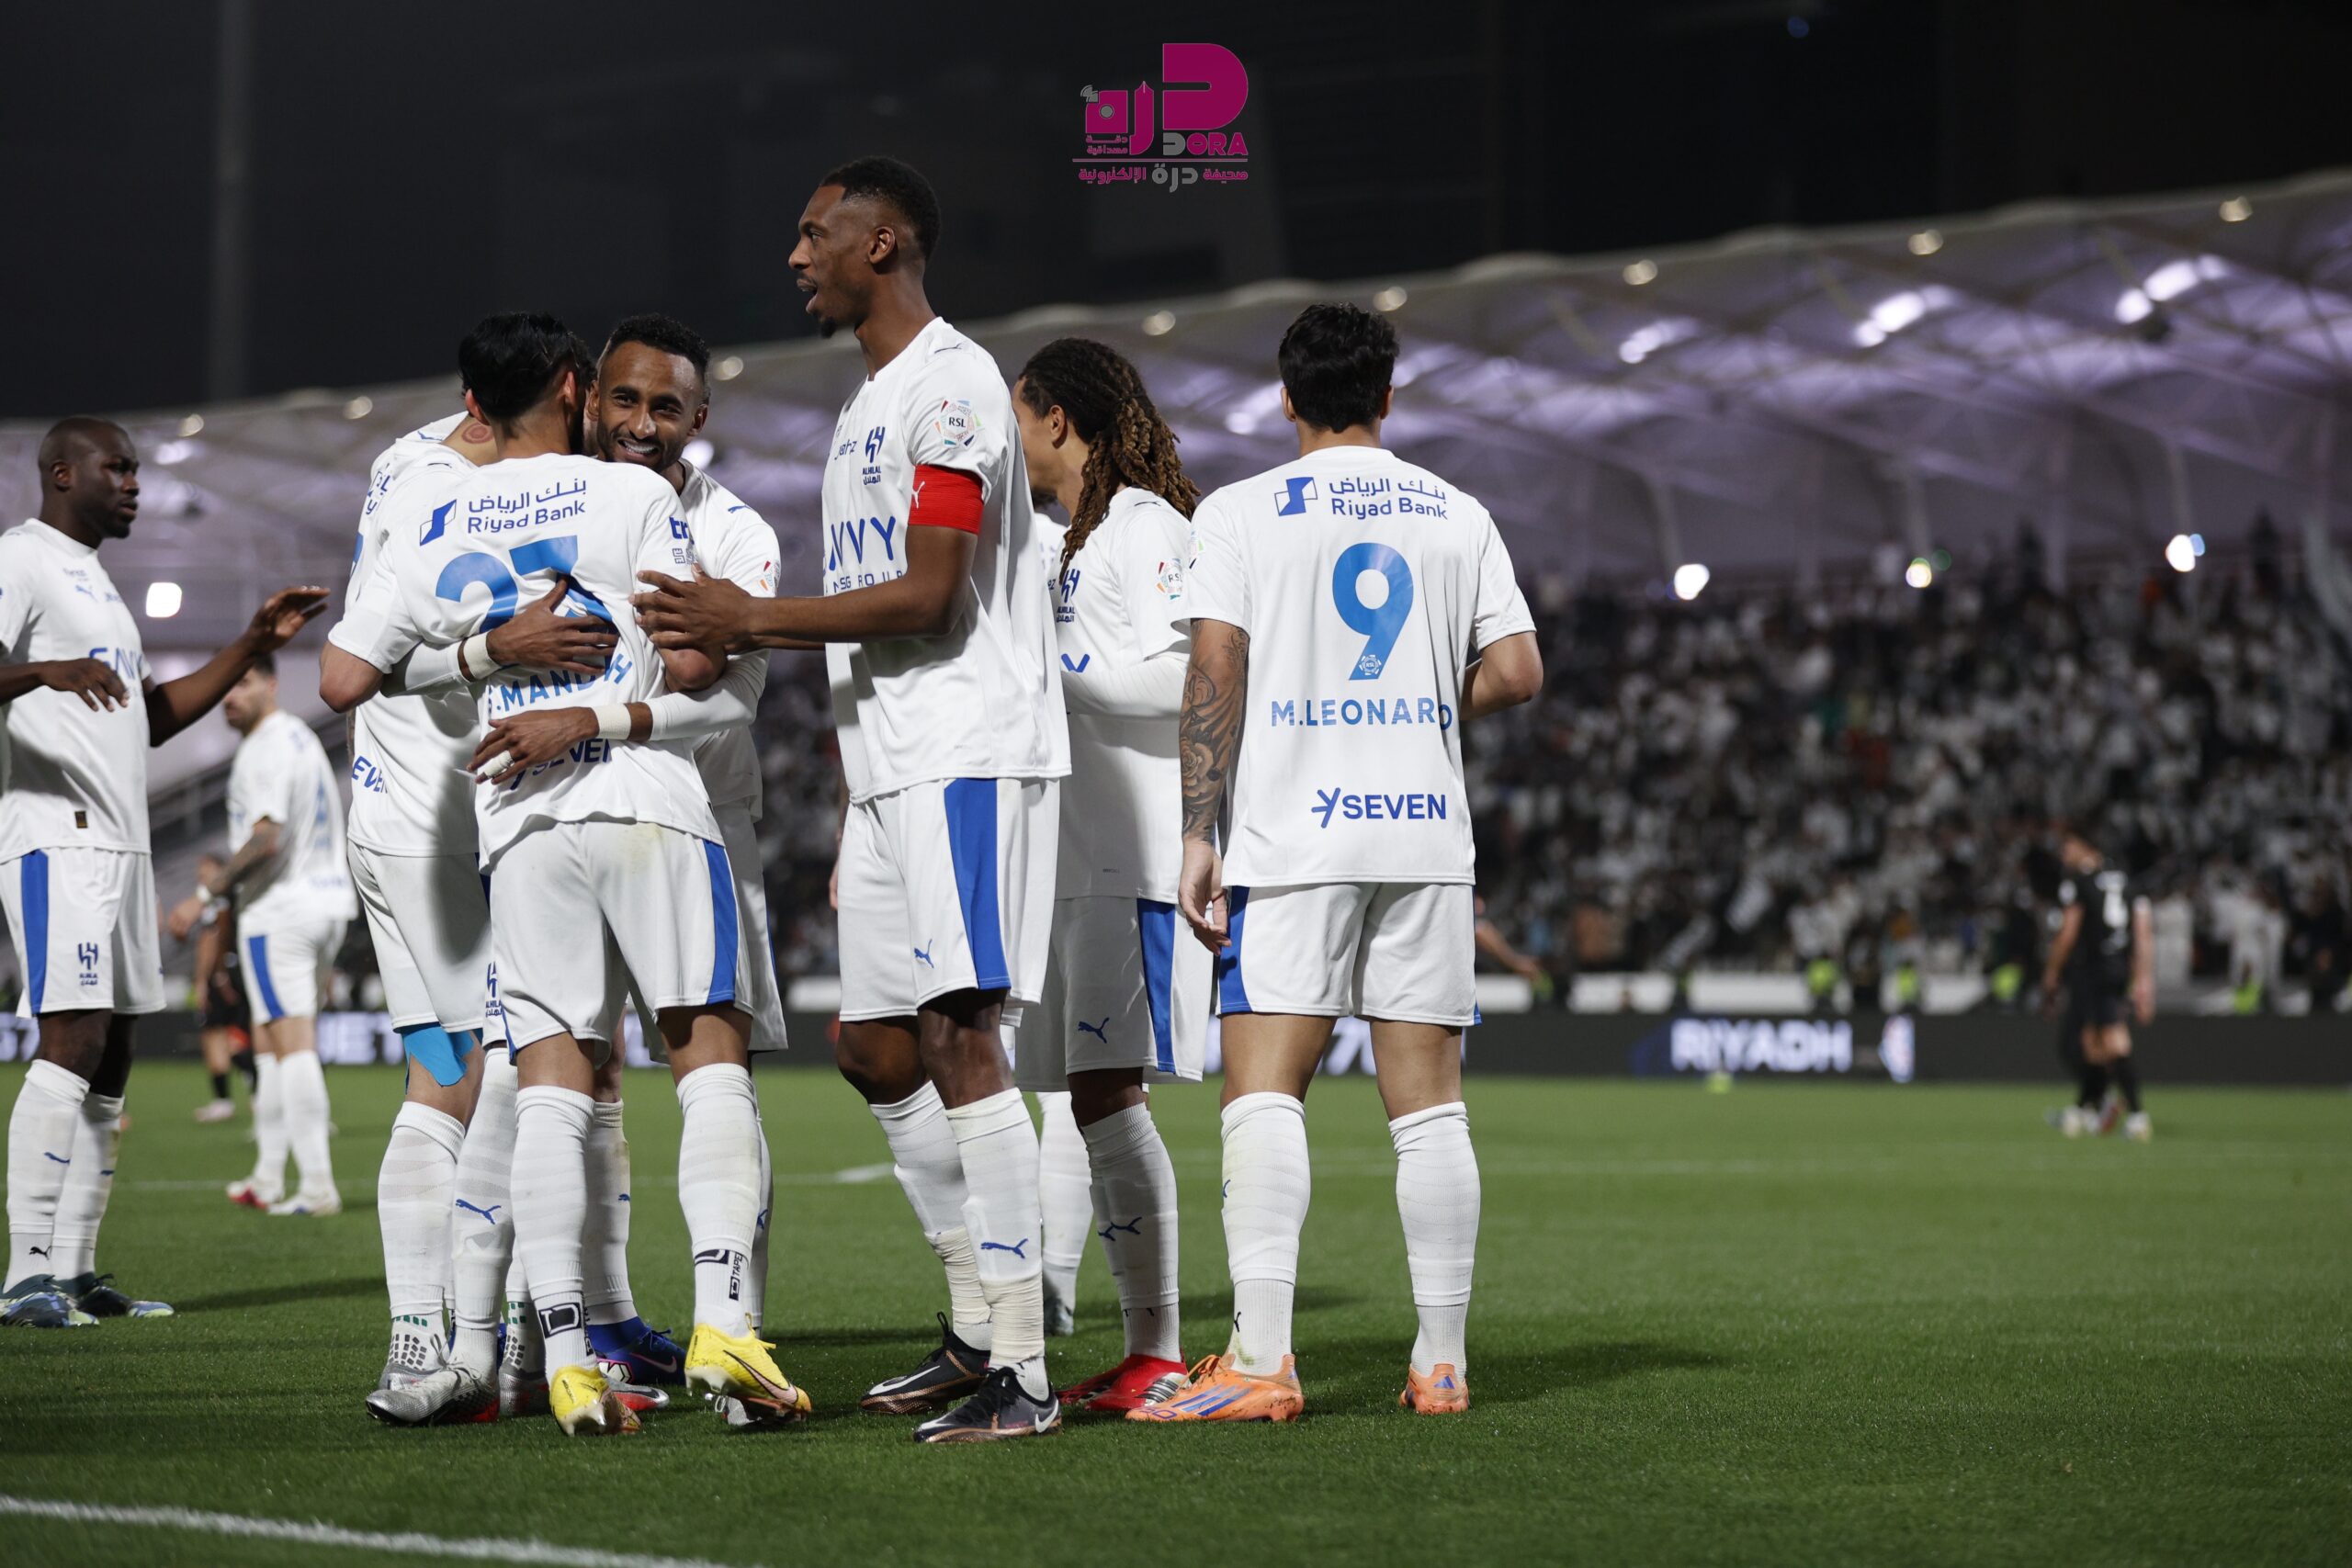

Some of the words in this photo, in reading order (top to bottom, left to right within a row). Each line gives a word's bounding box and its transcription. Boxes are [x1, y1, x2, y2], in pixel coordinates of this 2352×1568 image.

[948, 416, 967, 428] RSL
[1329, 477, 1391, 497] الرياض
[469, 491, 530, 514] الرياض
[1331, 497, 1393, 520] Riyad
[1398, 497, 1448, 520] Bank
[468, 513, 530, 535] Riyad
[535, 500, 586, 525] Bank
[1332, 542, 1414, 681] 9
[1342, 794, 1447, 820] SEVEN
[1670, 1018, 1854, 1073] RIYADH
